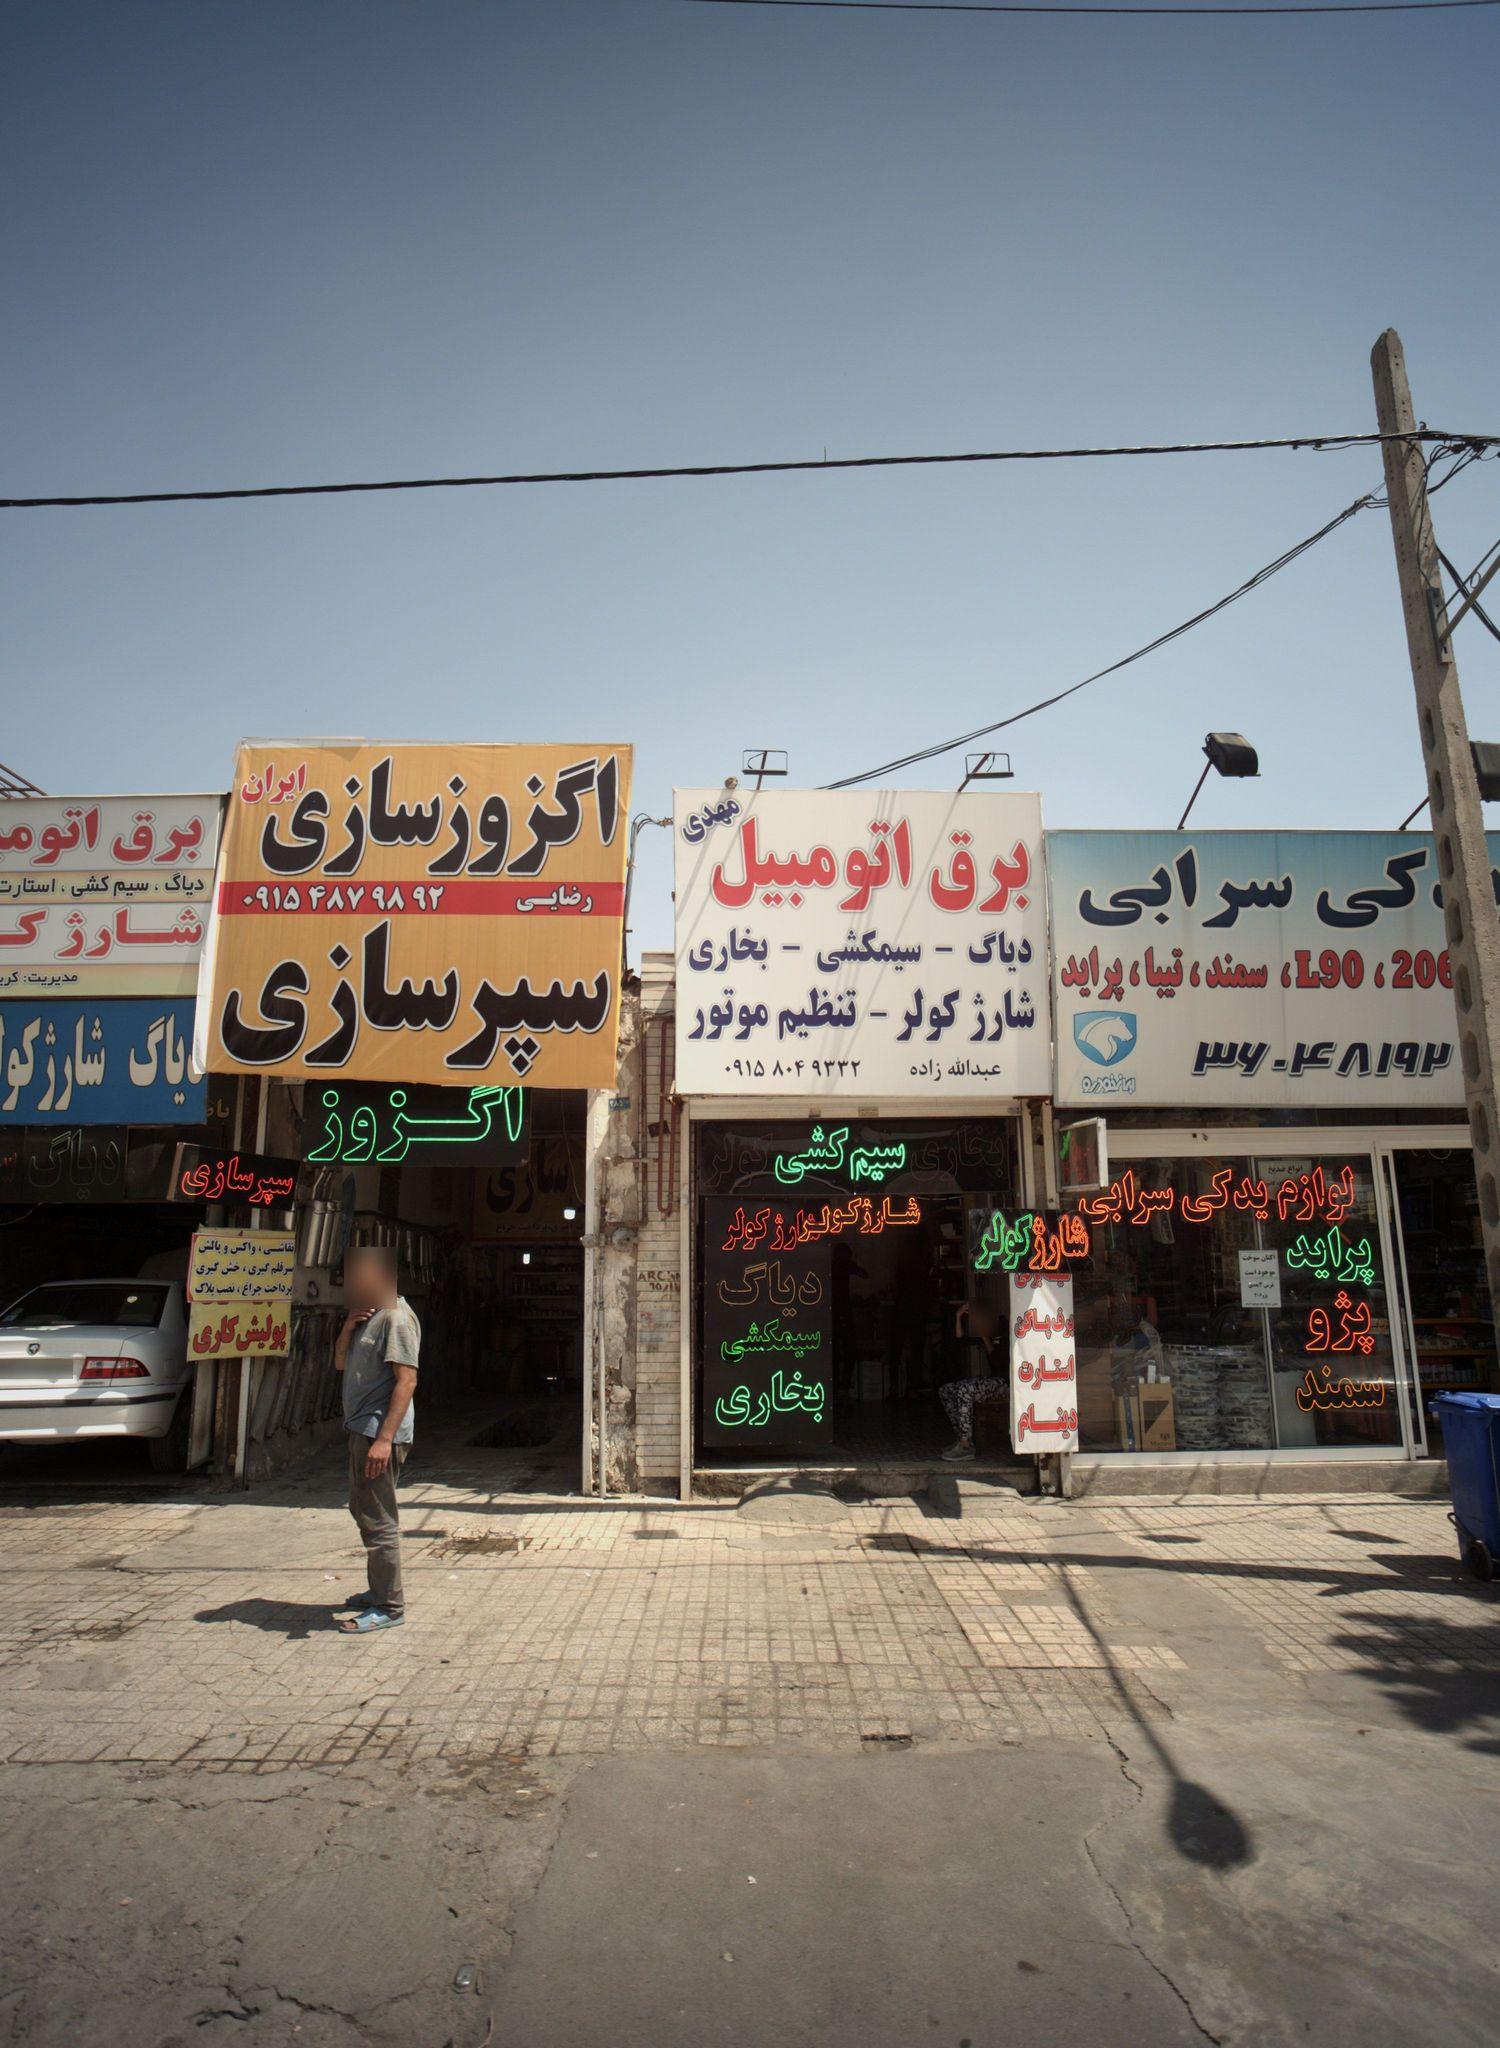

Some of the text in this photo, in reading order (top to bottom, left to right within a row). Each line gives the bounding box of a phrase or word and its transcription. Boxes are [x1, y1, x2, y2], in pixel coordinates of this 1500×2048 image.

[241, 762, 307, 804] ایران
[112, 811, 203, 863] برق
[681, 799, 740, 843] مهدی
[711, 816, 1032, 913] برق اتومبیل
[242, 884, 445, 911] ۰۹۱۵ ۴۸۷ ۹۸ ۹۲
[515, 884, 593, 913] رضایی
[56, 908, 202, 958] شارژ
[688, 927, 768, 972] بخاری
[816, 930, 922, 973] سیمکشی
[968, 929, 1033, 973] دیاگ
[1060, 945, 1123, 1001] پراید
[686, 988, 769, 1040] موتور
[777, 987, 857, 1041] تنظیم
[896, 988, 960, 1041] کولر
[969, 989, 1036, 1041] شارژ
[37, 1013, 105, 1112] شارژ
[725, 1059, 861, 1078] ۰۹۱۵ ۸۰۴ ۹۳۳۲
[909, 1059, 1002, 1083] عبدالله زاده
[308, 1085, 523, 1162] اگزوز
[774, 1125, 849, 1184] کشی
[849, 1142, 906, 1182] سیم
[1078, 1165, 1355, 1225] لوازم یدکی سرابی
[722, 1206, 771, 1251] کولر
[974, 1211, 1090, 1271] شارژ کولر
[1287, 1226, 1377, 1285] پراید
[718, 1261, 823, 1318] دیاگ
[192, 1313, 287, 1354] پولیش کاری
[1306, 1290, 1376, 1355] پژو
[715, 1370, 825, 1426] بخاری
[1018, 1355, 1075, 1390] استارت
[1297, 1364, 1385, 1413] سمند
[1018, 1402, 1079, 1442] دینام
